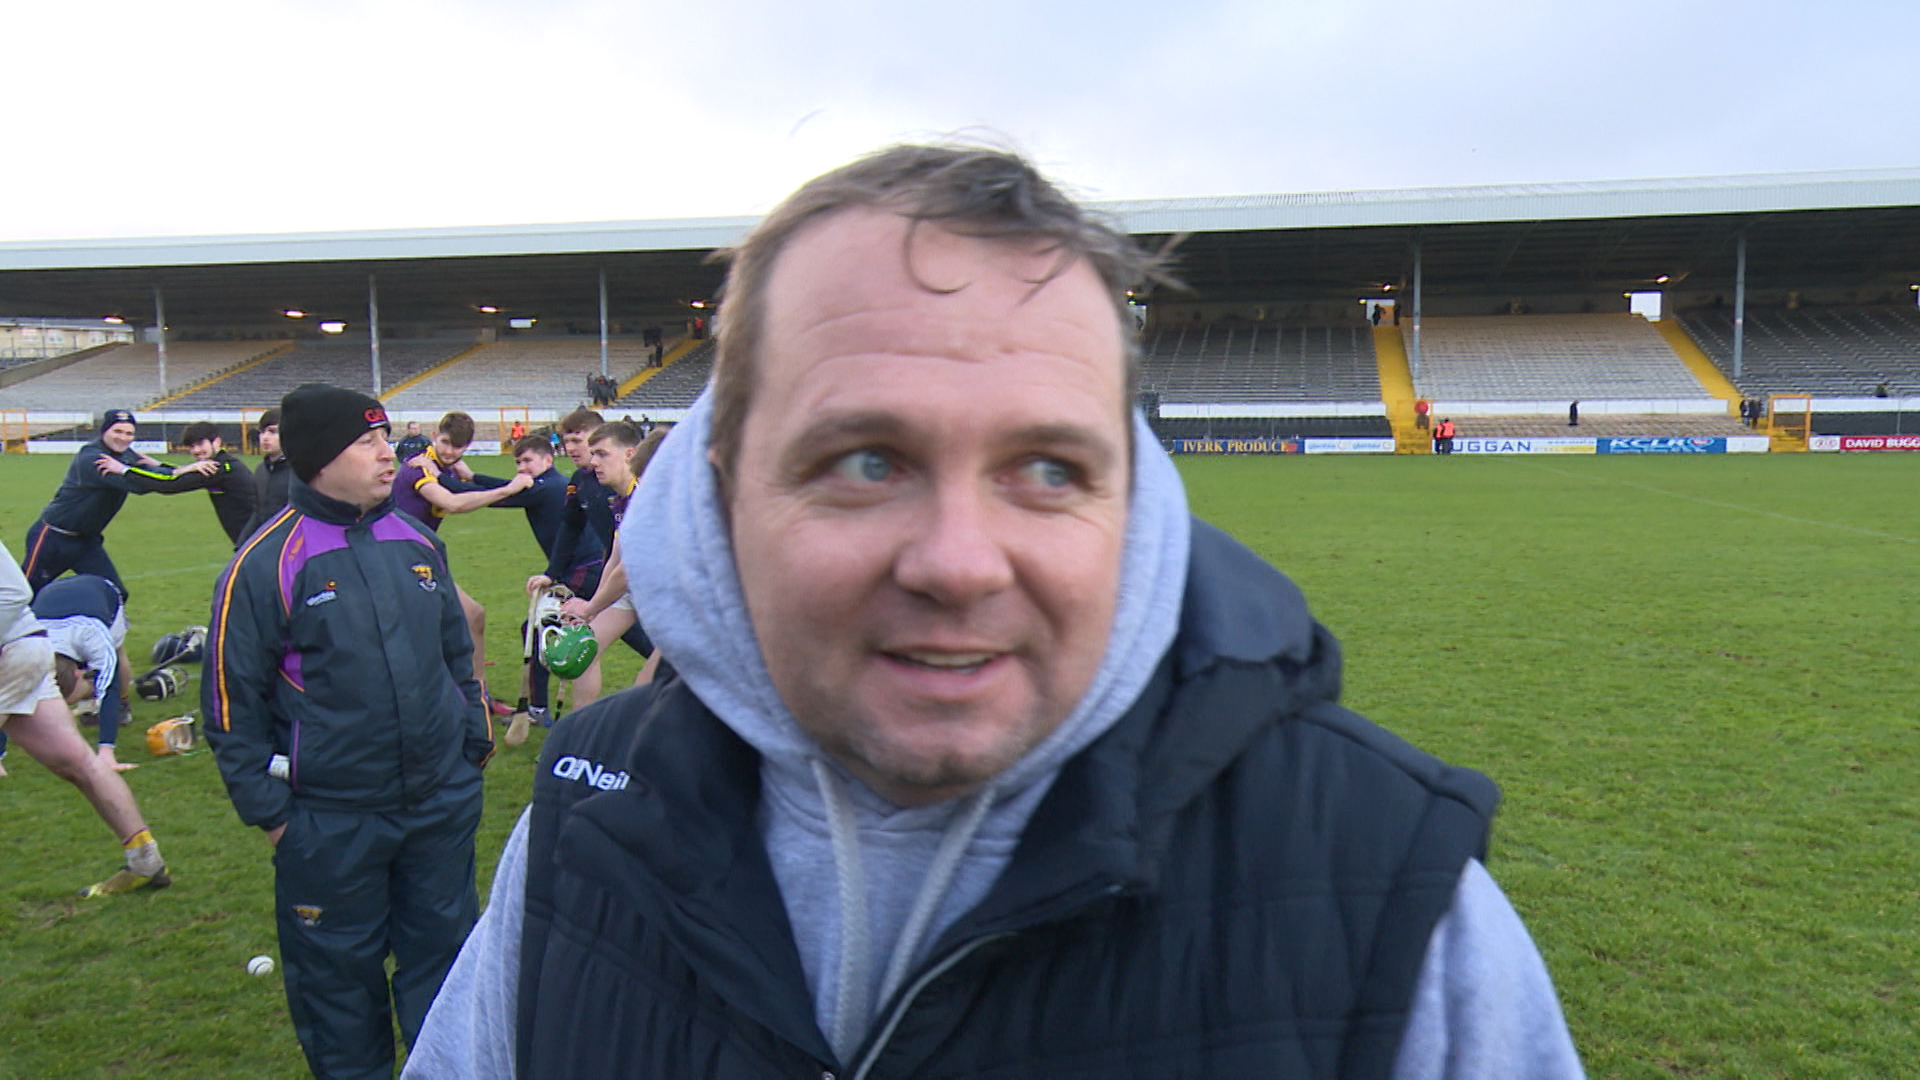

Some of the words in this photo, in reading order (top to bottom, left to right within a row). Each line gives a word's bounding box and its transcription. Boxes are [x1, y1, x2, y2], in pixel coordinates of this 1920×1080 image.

[1183, 440, 1224, 452] IVERK
[1451, 441, 1531, 452] UGGAN
[1845, 439, 1884, 448] DAVID
